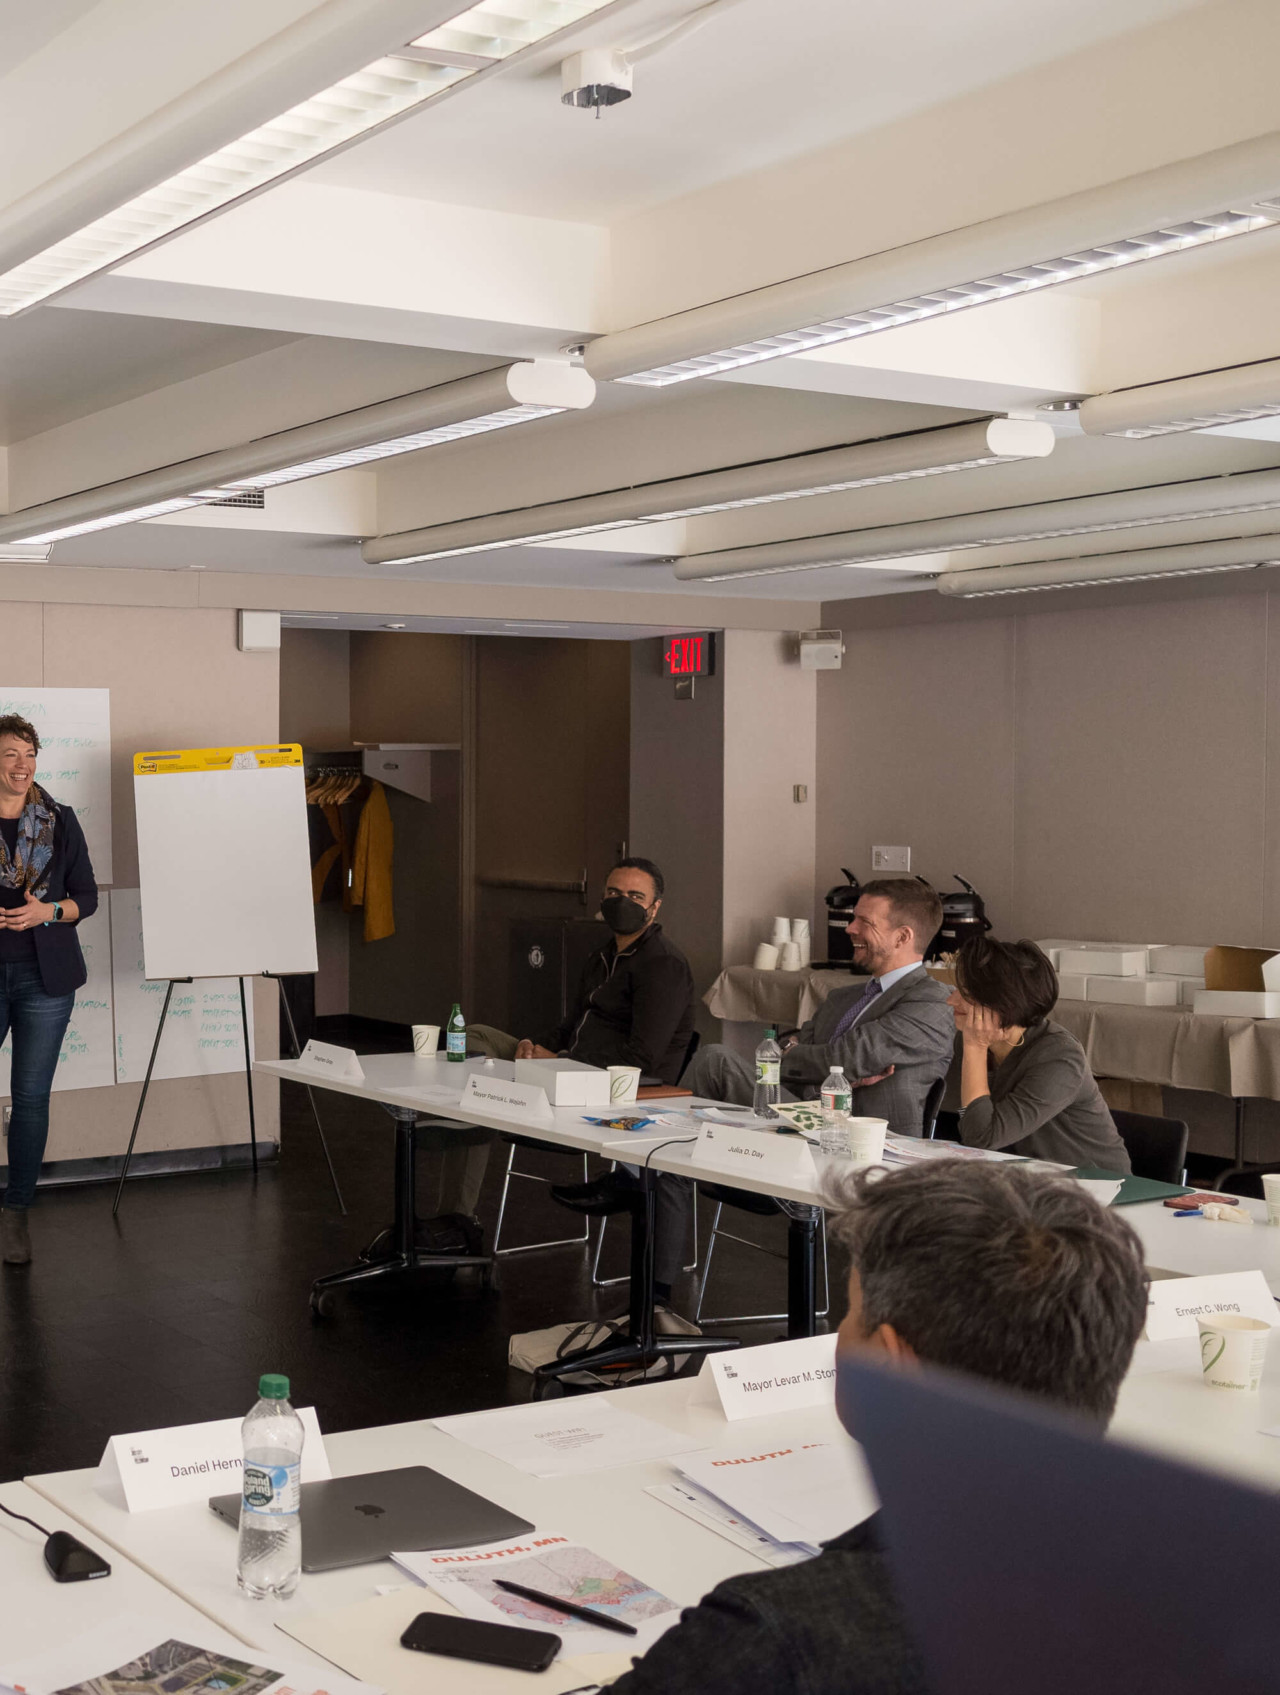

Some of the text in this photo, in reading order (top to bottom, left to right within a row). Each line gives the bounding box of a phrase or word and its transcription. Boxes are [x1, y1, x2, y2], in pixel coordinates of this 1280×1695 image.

[670, 637, 704, 674] EXIT
[728, 1146, 743, 1155] Julia
[751, 1150, 765, 1160] Day
[1175, 1303, 1241, 1317] Ernest C. Wong
[742, 1368, 838, 1393] Mayor Levar M. Ston
[170, 1458, 243, 1478] Daniel Hern
[431, 1536, 569, 1563] DULUTH, MN
